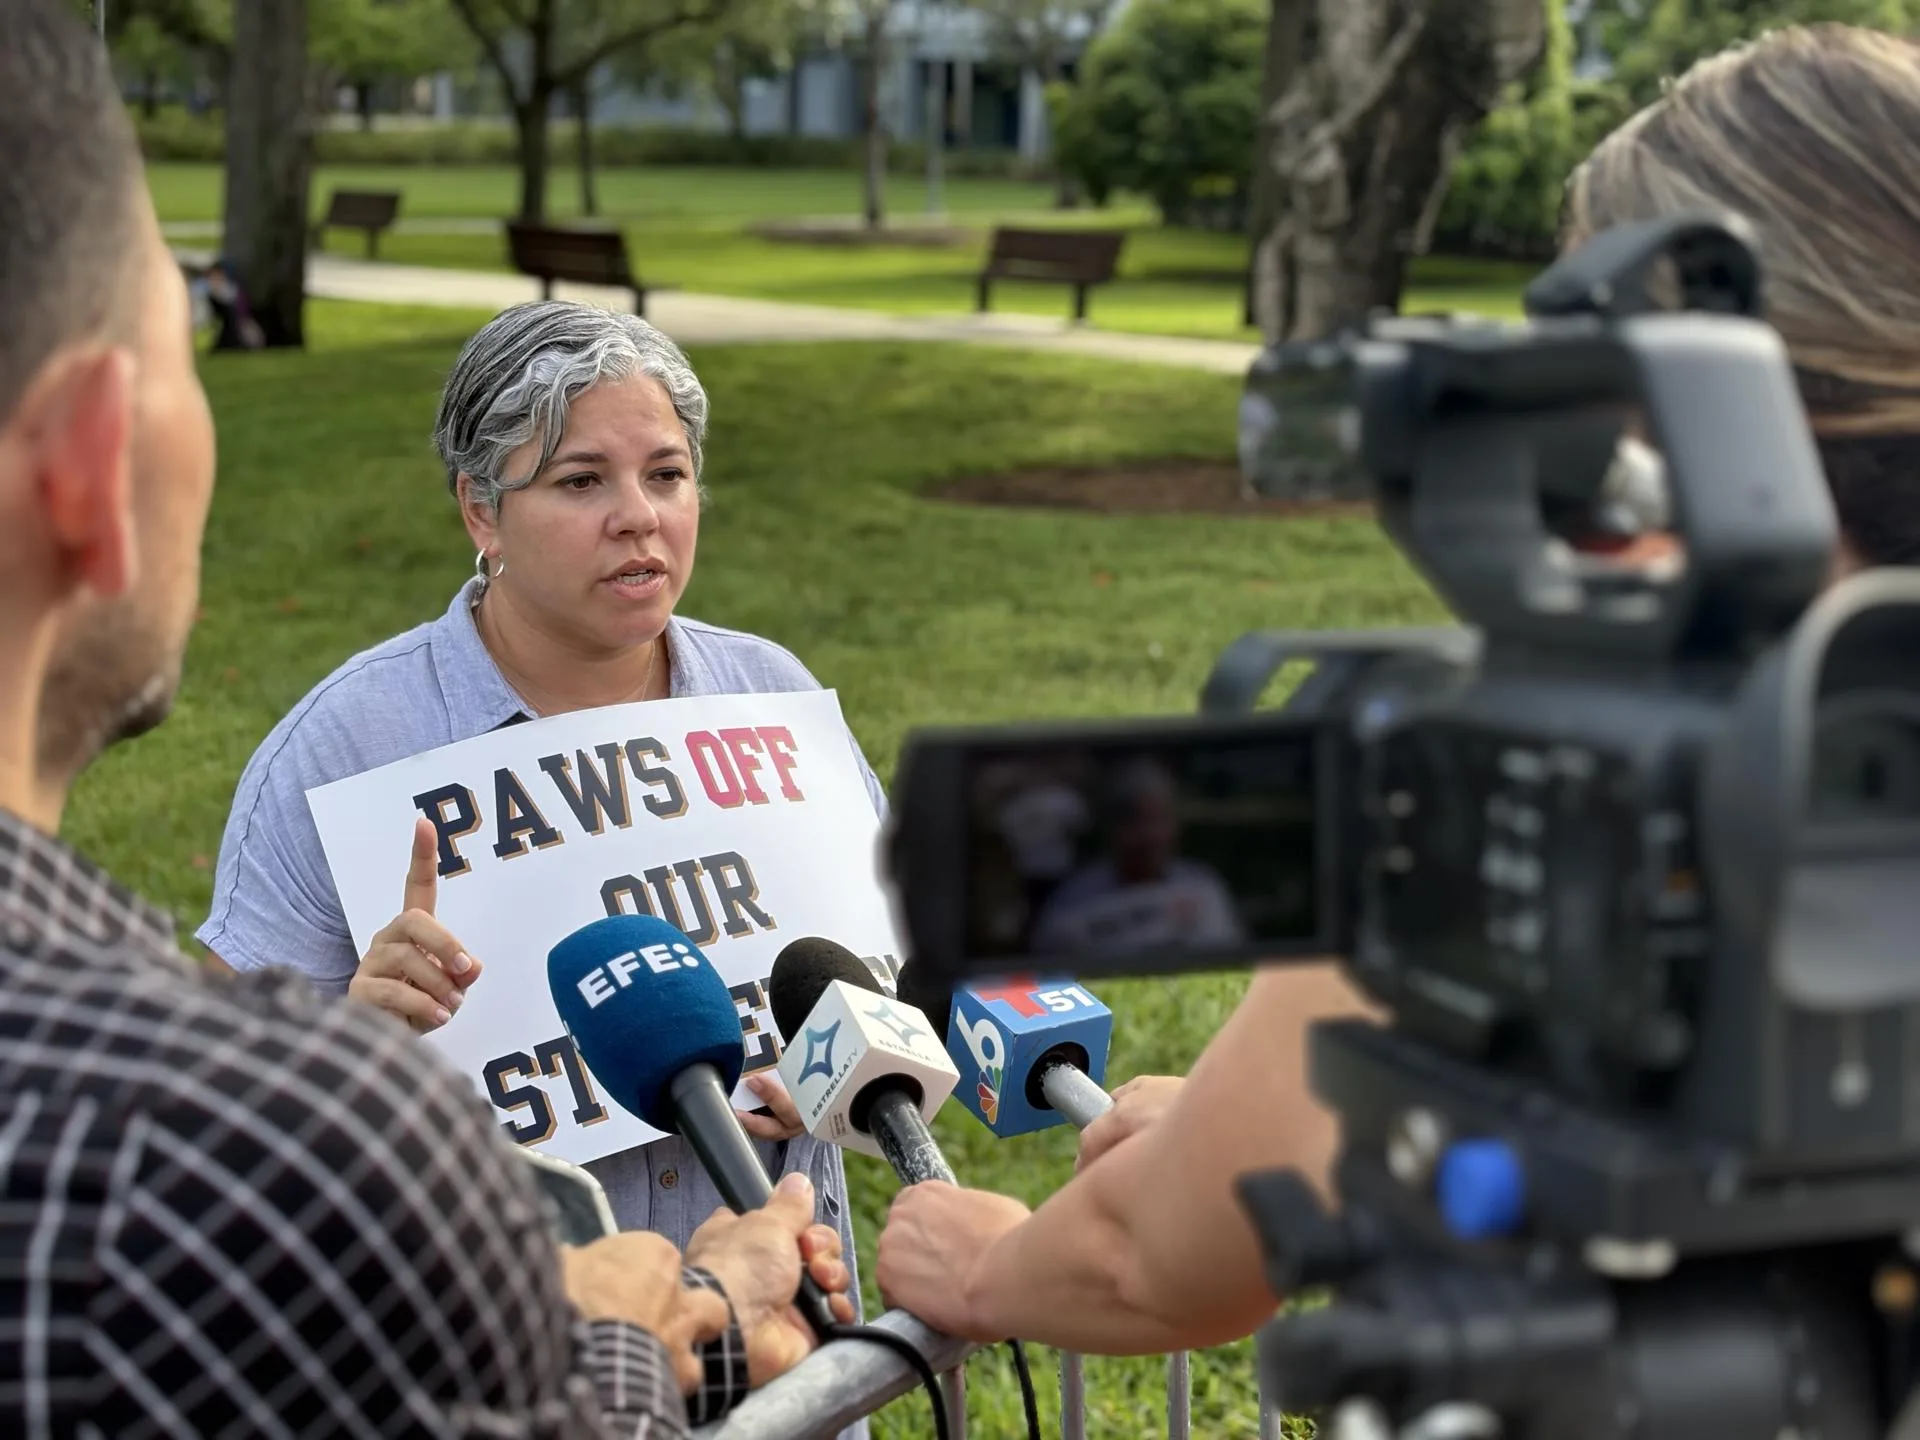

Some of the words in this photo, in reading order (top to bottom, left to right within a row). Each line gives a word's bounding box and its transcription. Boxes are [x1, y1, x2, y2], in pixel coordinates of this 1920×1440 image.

[413, 736, 690, 880] PAWS
[684, 725, 807, 810] OFF
[1037, 986, 1096, 1013] 51
